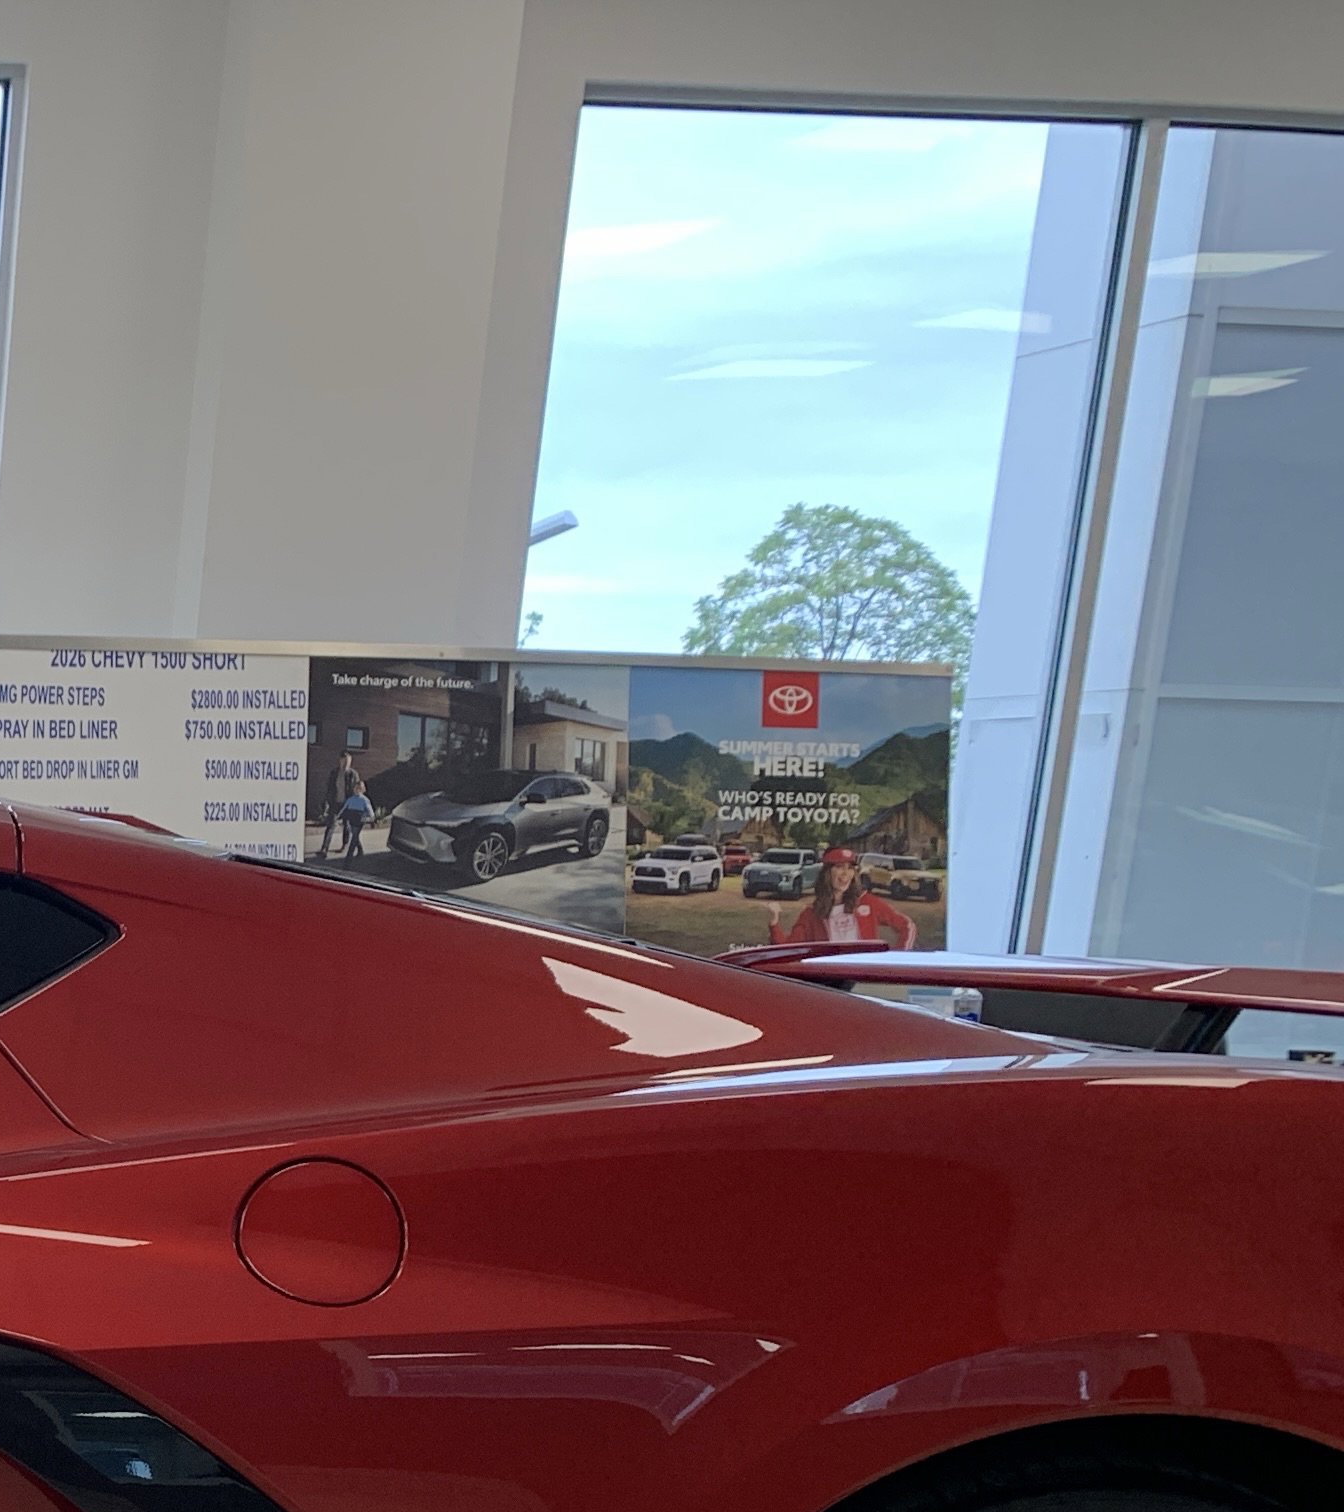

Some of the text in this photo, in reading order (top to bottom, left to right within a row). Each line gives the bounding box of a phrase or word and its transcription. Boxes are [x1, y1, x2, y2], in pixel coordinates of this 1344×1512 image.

[51, 650, 86, 668] 2026
[91, 651, 144, 669] CHEVY
[152, 652, 186, 669] 1500
[332, 673, 474, 689] Take charge of the future.
[21, 686, 64, 705] POWER
[67, 688, 105, 707] STEPS
[191, 690, 306, 710] $2800.00 INSTALLED
[32, 720, 45, 738] IN
[49, 720, 76, 739] BED
[80, 720, 118, 739] LINER
[185, 720, 306, 741] $750.00 INSTALLED
[718, 740, 861, 757] SUMMER STARTS
[22, 760, 44, 779] BED
[46, 760, 74, 779] DROP
[77, 760, 87, 779] IN
[90, 760, 120, 779] LINER
[122, 760, 139, 779] GM
[205, 760, 299, 781] $500.00 INSTALLED
[753, 755, 825, 777] HERE!
[718, 790, 860, 807] WHO'S READY FOR
[204, 801, 298, 822] $225.00 INSTALLED
[717, 805, 860, 824] CAMP TOYOTA?
